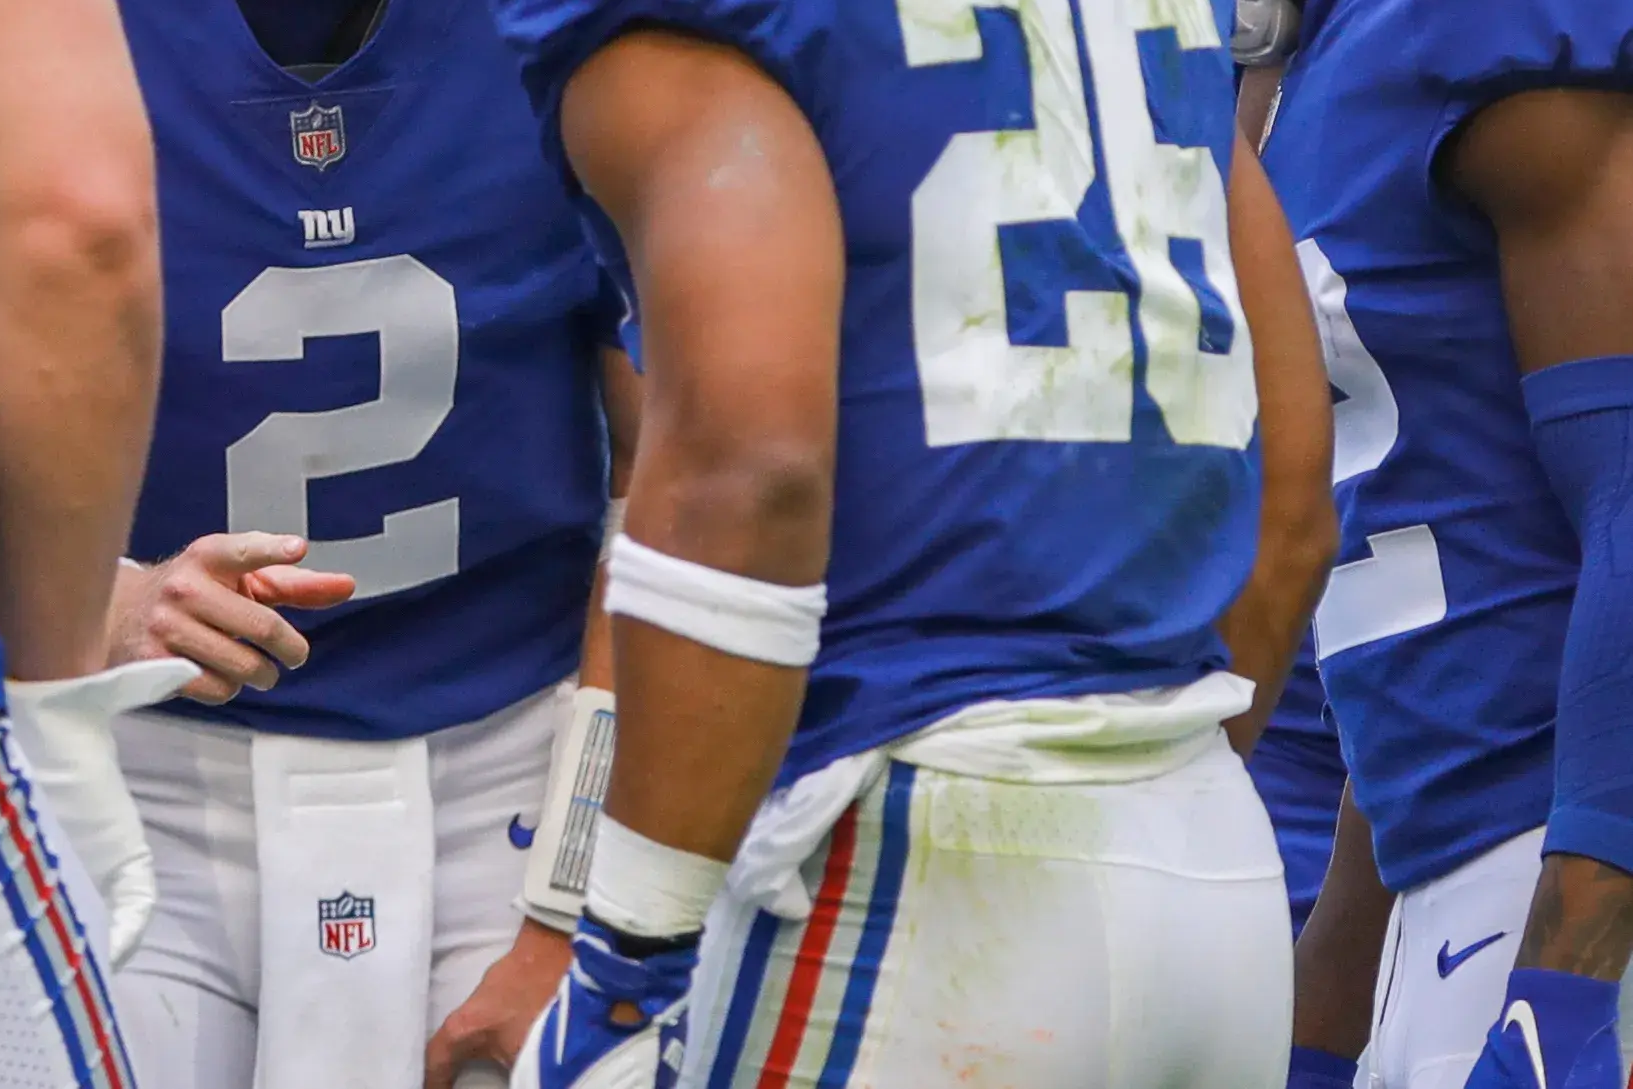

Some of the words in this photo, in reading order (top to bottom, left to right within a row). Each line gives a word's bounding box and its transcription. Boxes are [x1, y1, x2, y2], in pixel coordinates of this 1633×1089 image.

[300, 131, 340, 159] NFL
[221, 254, 459, 603] 2
[325, 921, 371, 953] NFL
